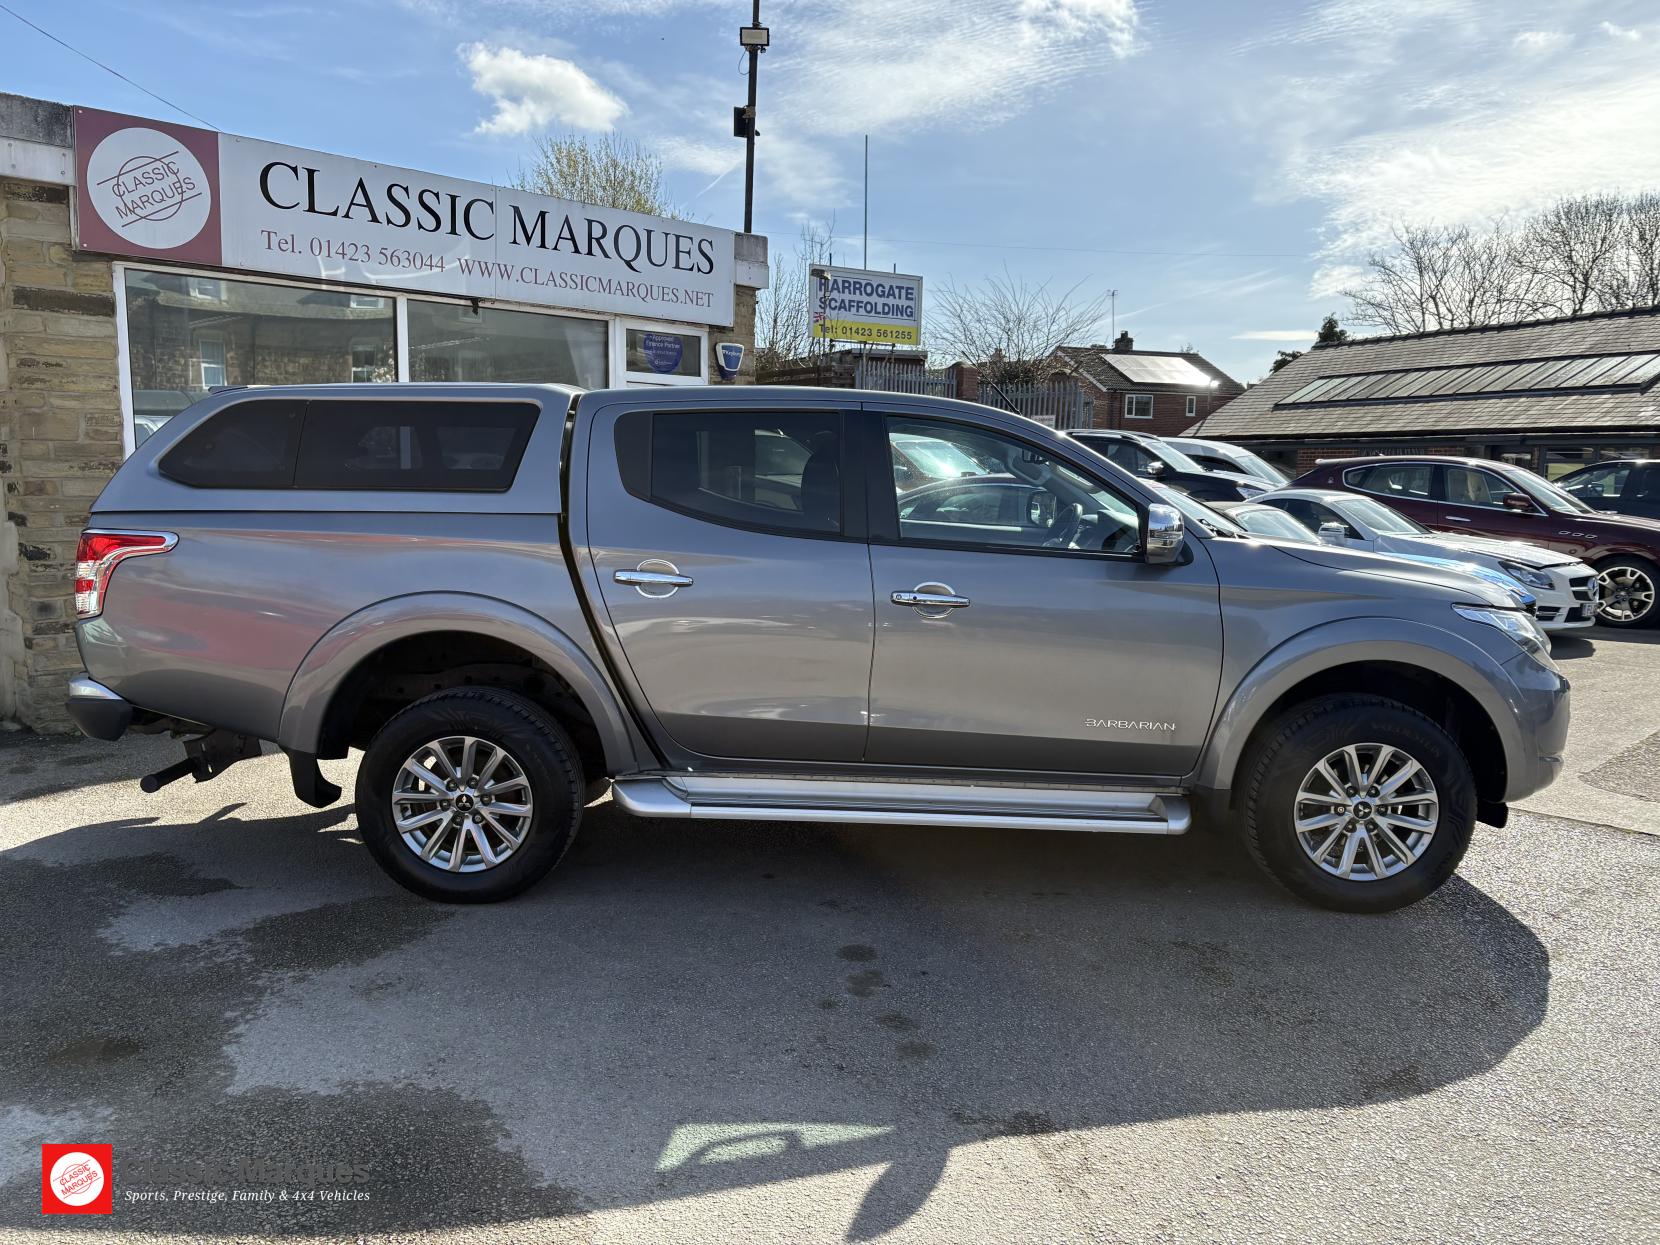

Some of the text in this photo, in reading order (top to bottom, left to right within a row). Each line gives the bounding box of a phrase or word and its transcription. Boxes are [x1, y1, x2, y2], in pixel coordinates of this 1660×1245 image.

[112, 161, 180, 197] CLASSIC
[115, 177, 196, 219] MARQUES
[259, 161, 715, 275] CLASSIC MARQUES
[260, 229, 714, 308] Tel. 01423 563044 WWW.CLASSICMARQUES.NET
[818, 296, 914, 318] SCAFFOLDING
[841, 325, 873, 337] 01423
[876, 328, 912, 341] 561255
[1084, 718, 1176, 731] BARBARIAN
